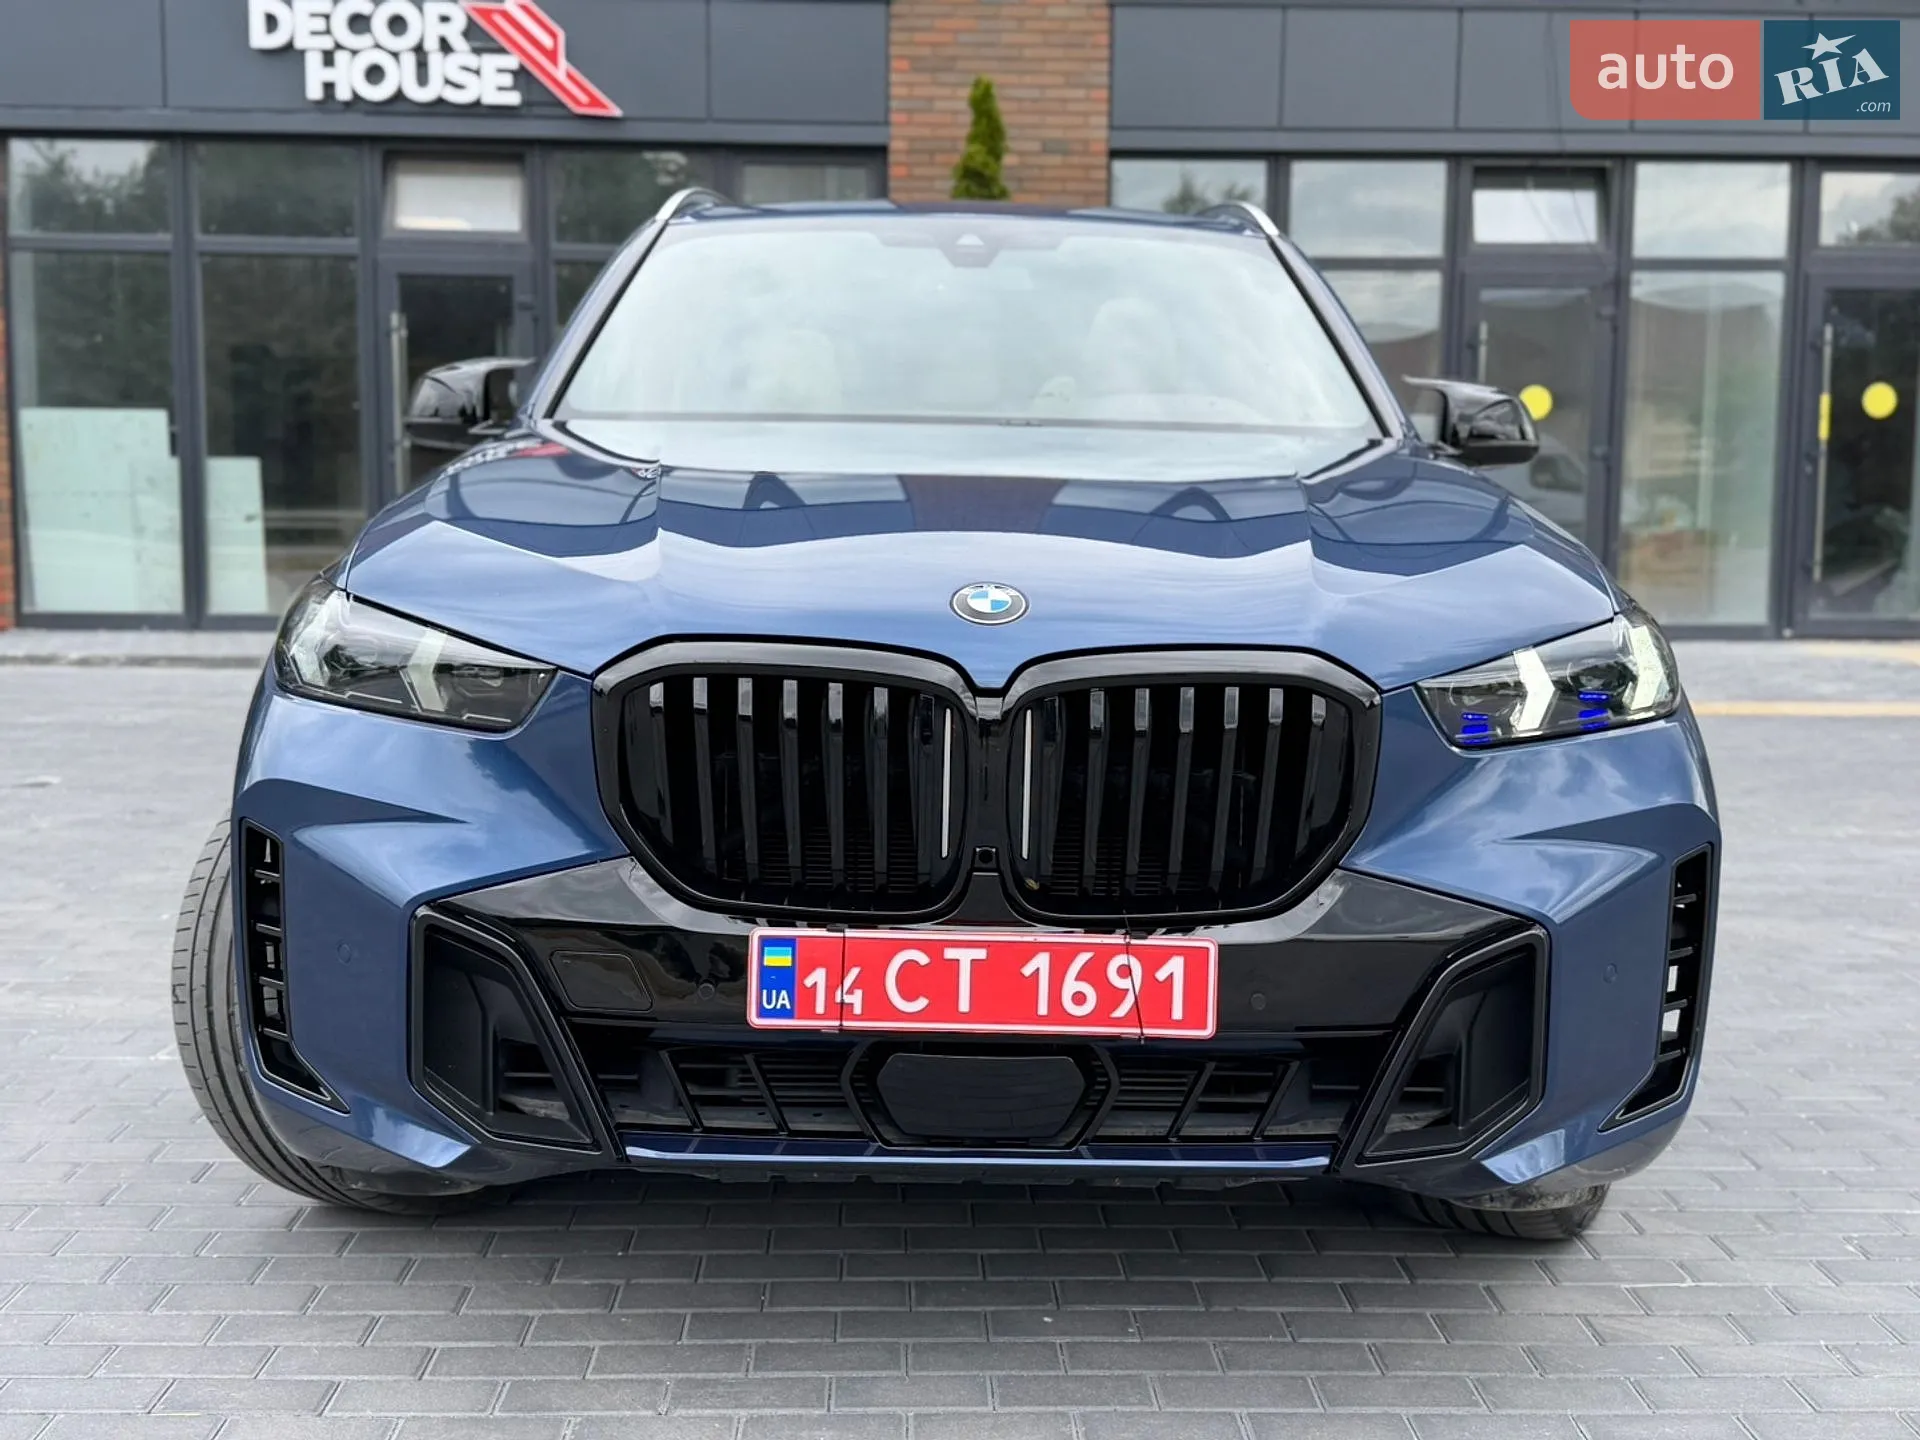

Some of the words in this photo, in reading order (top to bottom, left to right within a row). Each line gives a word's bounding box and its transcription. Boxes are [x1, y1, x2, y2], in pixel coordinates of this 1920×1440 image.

[248, 0, 470, 52] DECOR
[305, 47, 521, 106] HOUSE
[762, 988, 791, 1009] UA
[803, 966, 863, 1015] 14
[884, 947, 988, 1013] CT
[1020, 951, 1186, 1021] 1691
